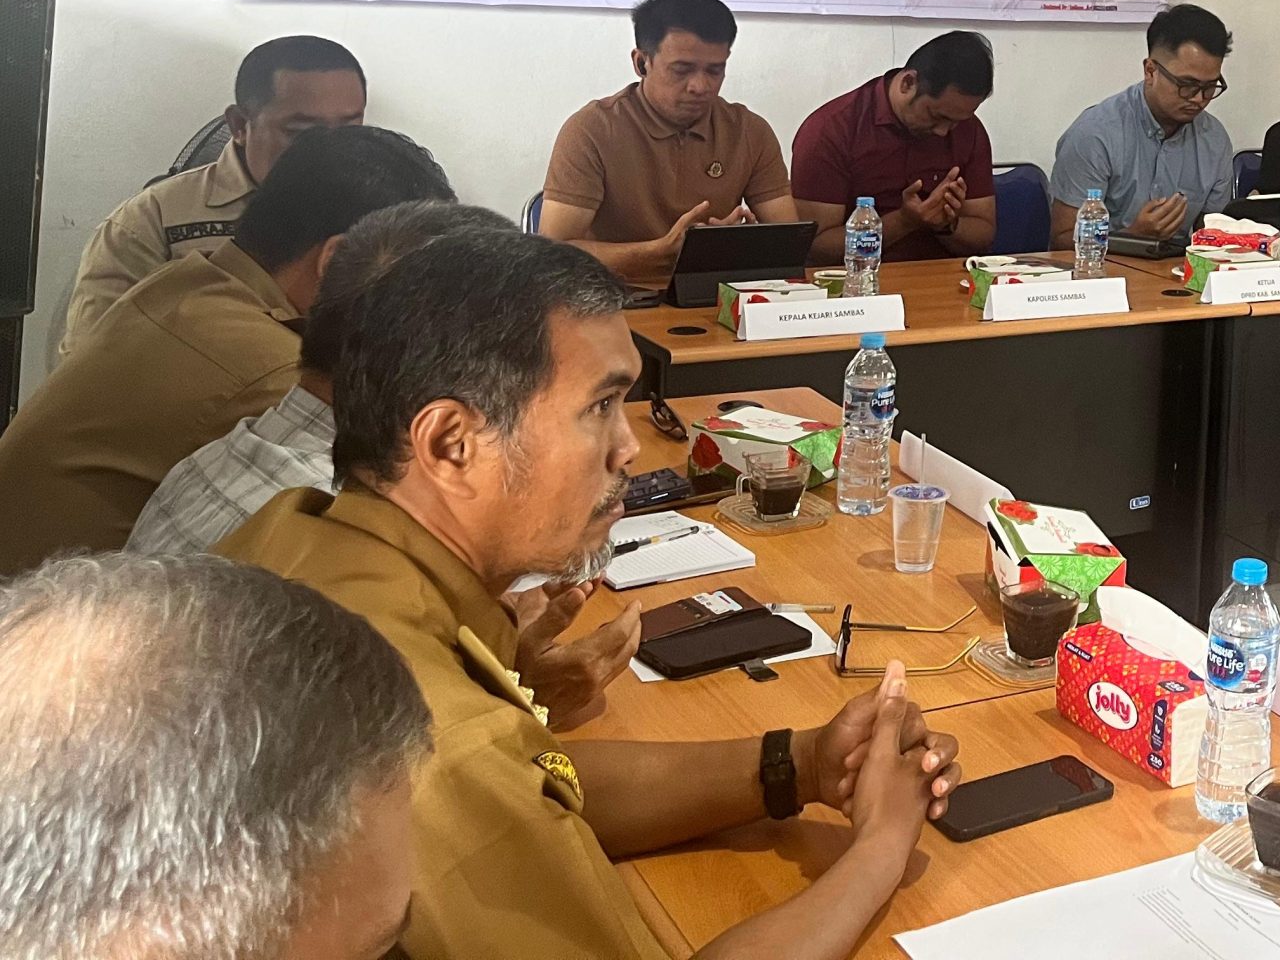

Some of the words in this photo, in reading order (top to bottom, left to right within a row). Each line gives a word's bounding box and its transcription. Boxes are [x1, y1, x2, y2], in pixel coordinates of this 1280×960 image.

[1027, 294, 1058, 302] KAPOLRES
[808, 311, 833, 319] KEJARI
[835, 309, 865, 318] SAMBAS
[1223, 657, 1246, 675] Life
[1094, 684, 1131, 724] jolly
